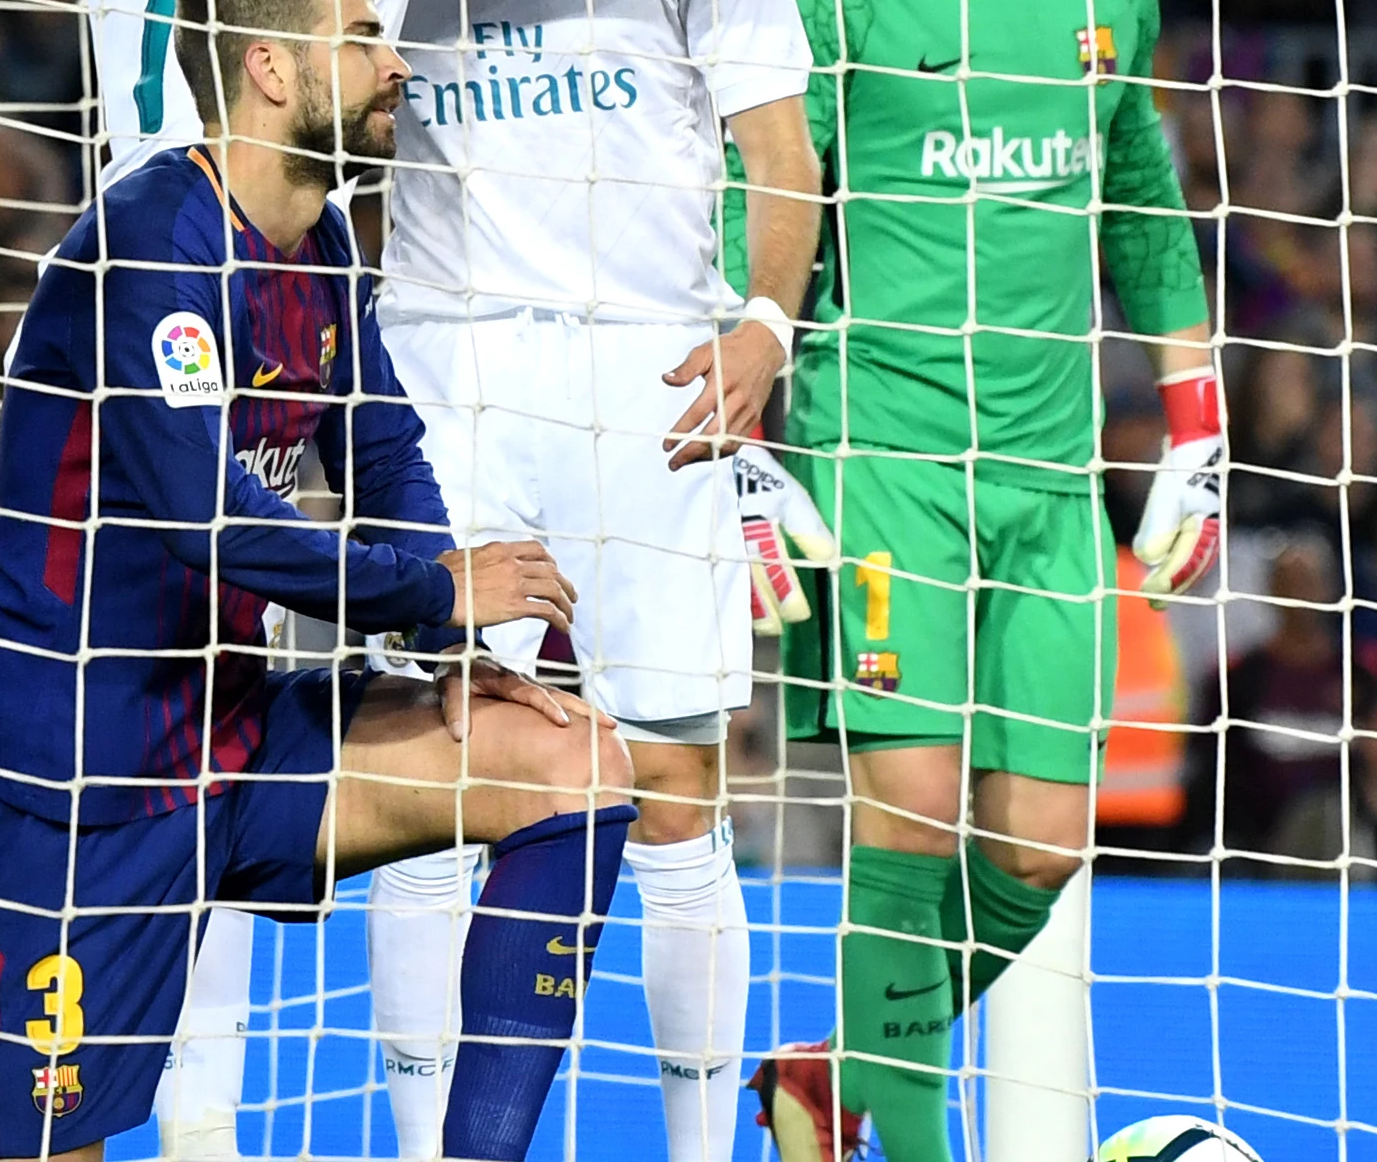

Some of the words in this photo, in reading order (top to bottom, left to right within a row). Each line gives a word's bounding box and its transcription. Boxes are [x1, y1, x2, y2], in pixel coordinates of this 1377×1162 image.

[472, 20, 544, 63] Fly
[402, 64, 638, 128] Emirates
[854, 551, 893, 641] 1
[25, 954, 85, 1056] 3
[385, 1057, 454, 1076] RMCF
